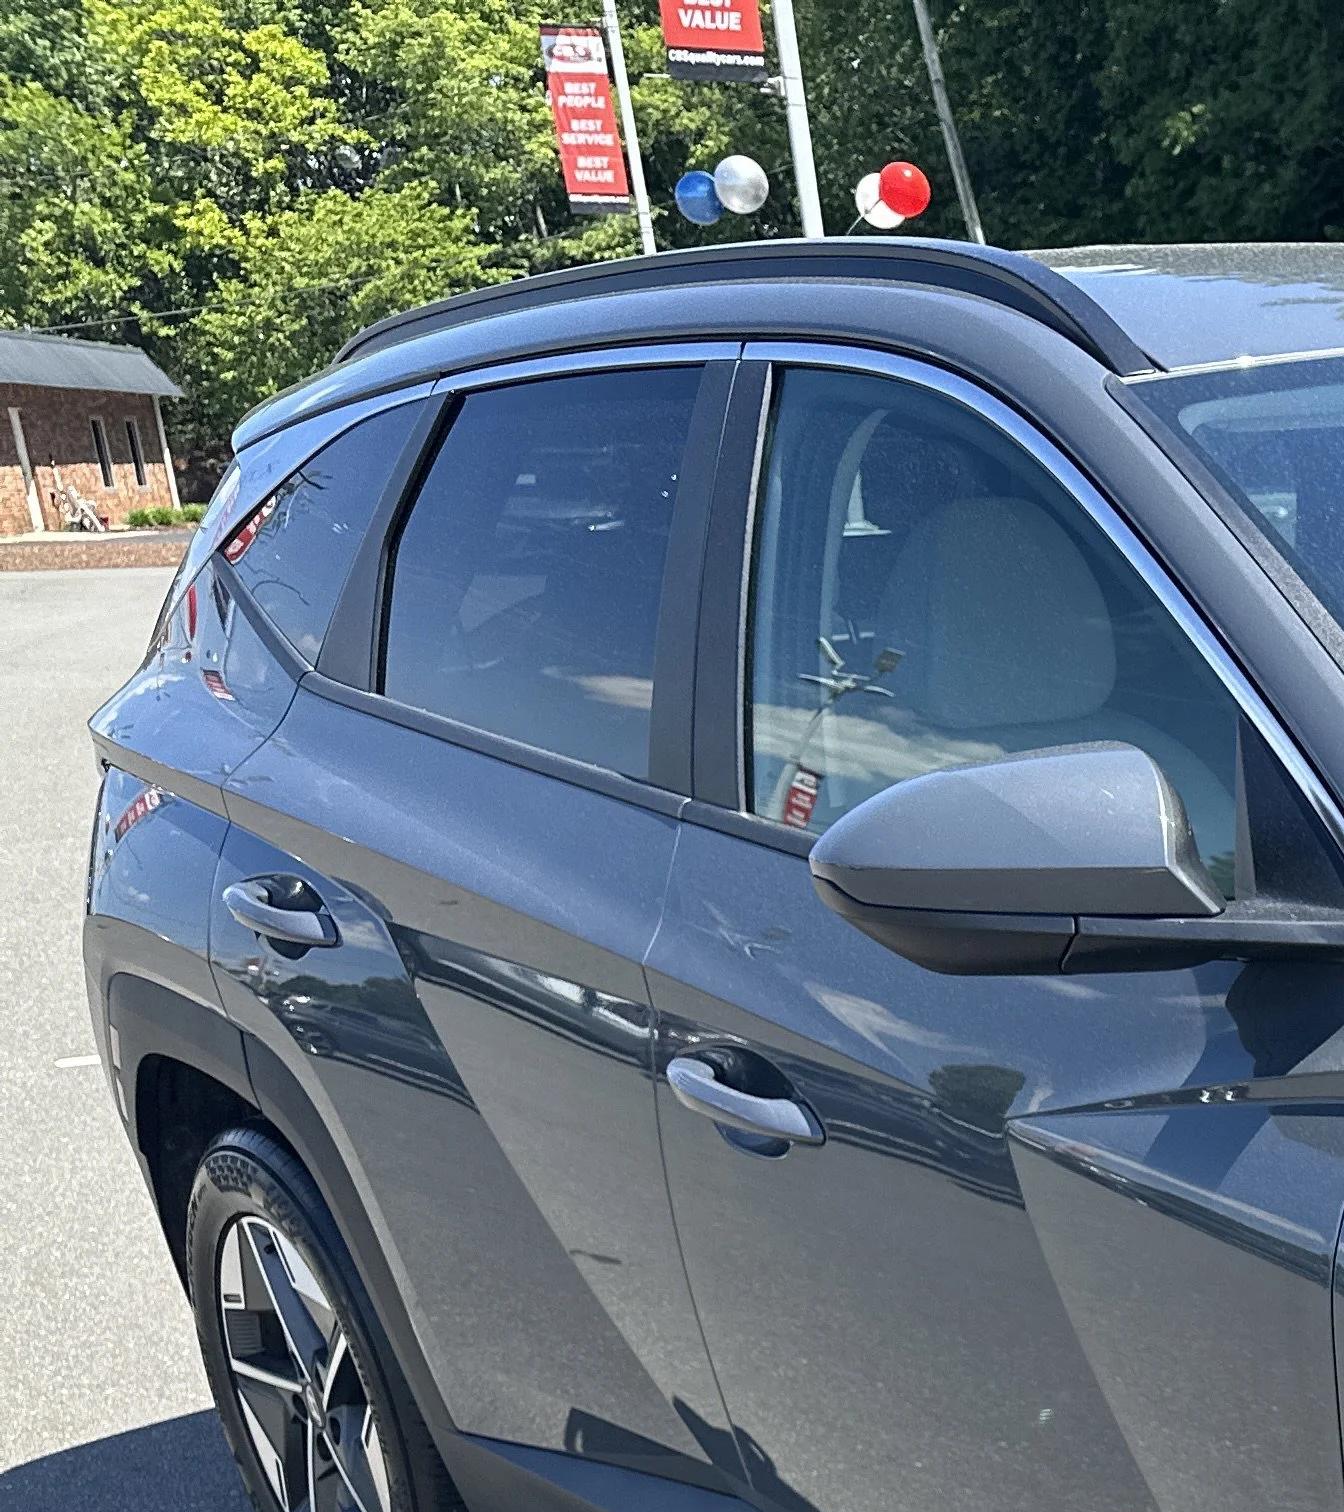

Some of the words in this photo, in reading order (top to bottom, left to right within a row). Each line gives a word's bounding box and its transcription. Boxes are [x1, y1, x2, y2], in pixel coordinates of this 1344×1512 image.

[677, 8, 742, 31] VALUE
[563, 82, 597, 94] BEST
[557, 95, 606, 109] PEOPLE
[570, 118, 603, 131] BEST
[561, 132, 615, 147] SERVICE
[576, 156, 609, 169] BEST
[573, 169, 615, 183] VALUE
